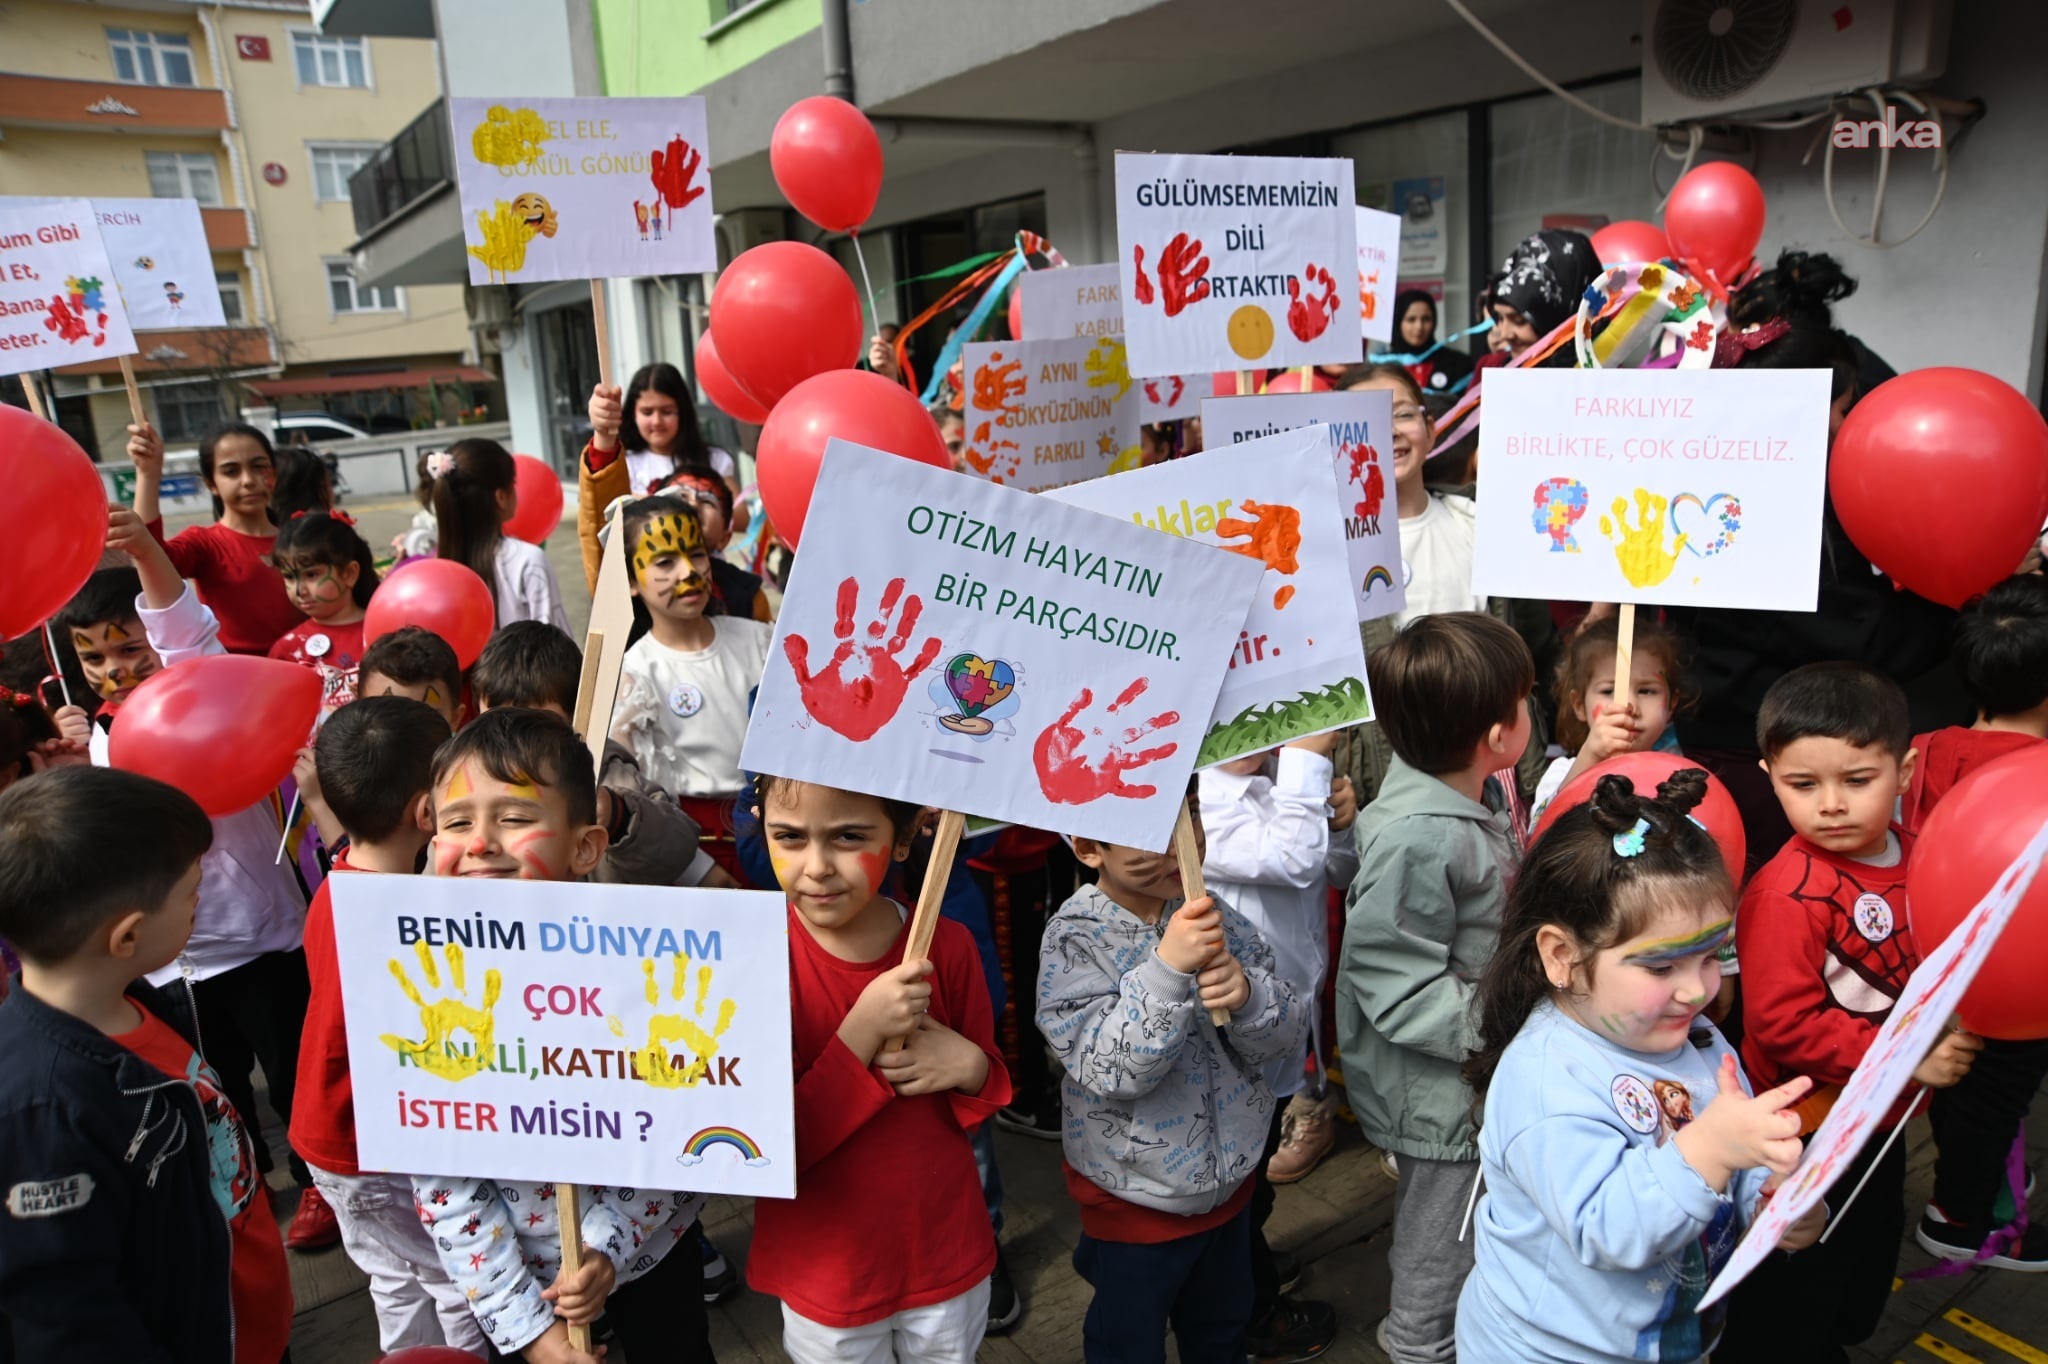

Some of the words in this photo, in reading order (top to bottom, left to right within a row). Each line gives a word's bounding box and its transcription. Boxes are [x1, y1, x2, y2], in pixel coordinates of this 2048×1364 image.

[577, 119, 618, 141] ELE,
[1136, 178, 1339, 208] GÜLÜMSEMEMİZİN
[36, 223, 80, 244] Gibi
[1225, 223, 1265, 251] DİLİ
[8, 263, 40, 281] Et,
[1040, 361, 1078, 384] AYNI
[1003, 397, 1113, 428] GÖKYÜZÜNÜN
[1574, 397, 1695, 419] FARKLIYIZ
[1033, 440, 1085, 465] FARKLI
[1505, 433, 1615, 460] BİRLİKTE,
[1623, 437, 1676, 463] ÇOK
[1682, 435, 1796, 463] GÜZELİZ.
[907, 505, 1017, 558] OTİZM
[1023, 536, 1163, 598] HAYATIN
[934, 572, 988, 611] BİR
[995, 589, 1182, 662] PARÇASIDIR.
[397, 911, 526, 951] BENİM
[538, 915, 722, 961] DÜNYAM
[523, 983, 603, 1021] ÇOK
[397, 1091, 499, 1132] İSTER
[510, 1100, 622, 1139] MİSİN
[633, 1111, 654, 1142] ?
[1163, 1144, 1187, 1165] COOL
[20, 1178, 80, 1198] HUSTLE
[21, 1191, 79, 1212] HEART
